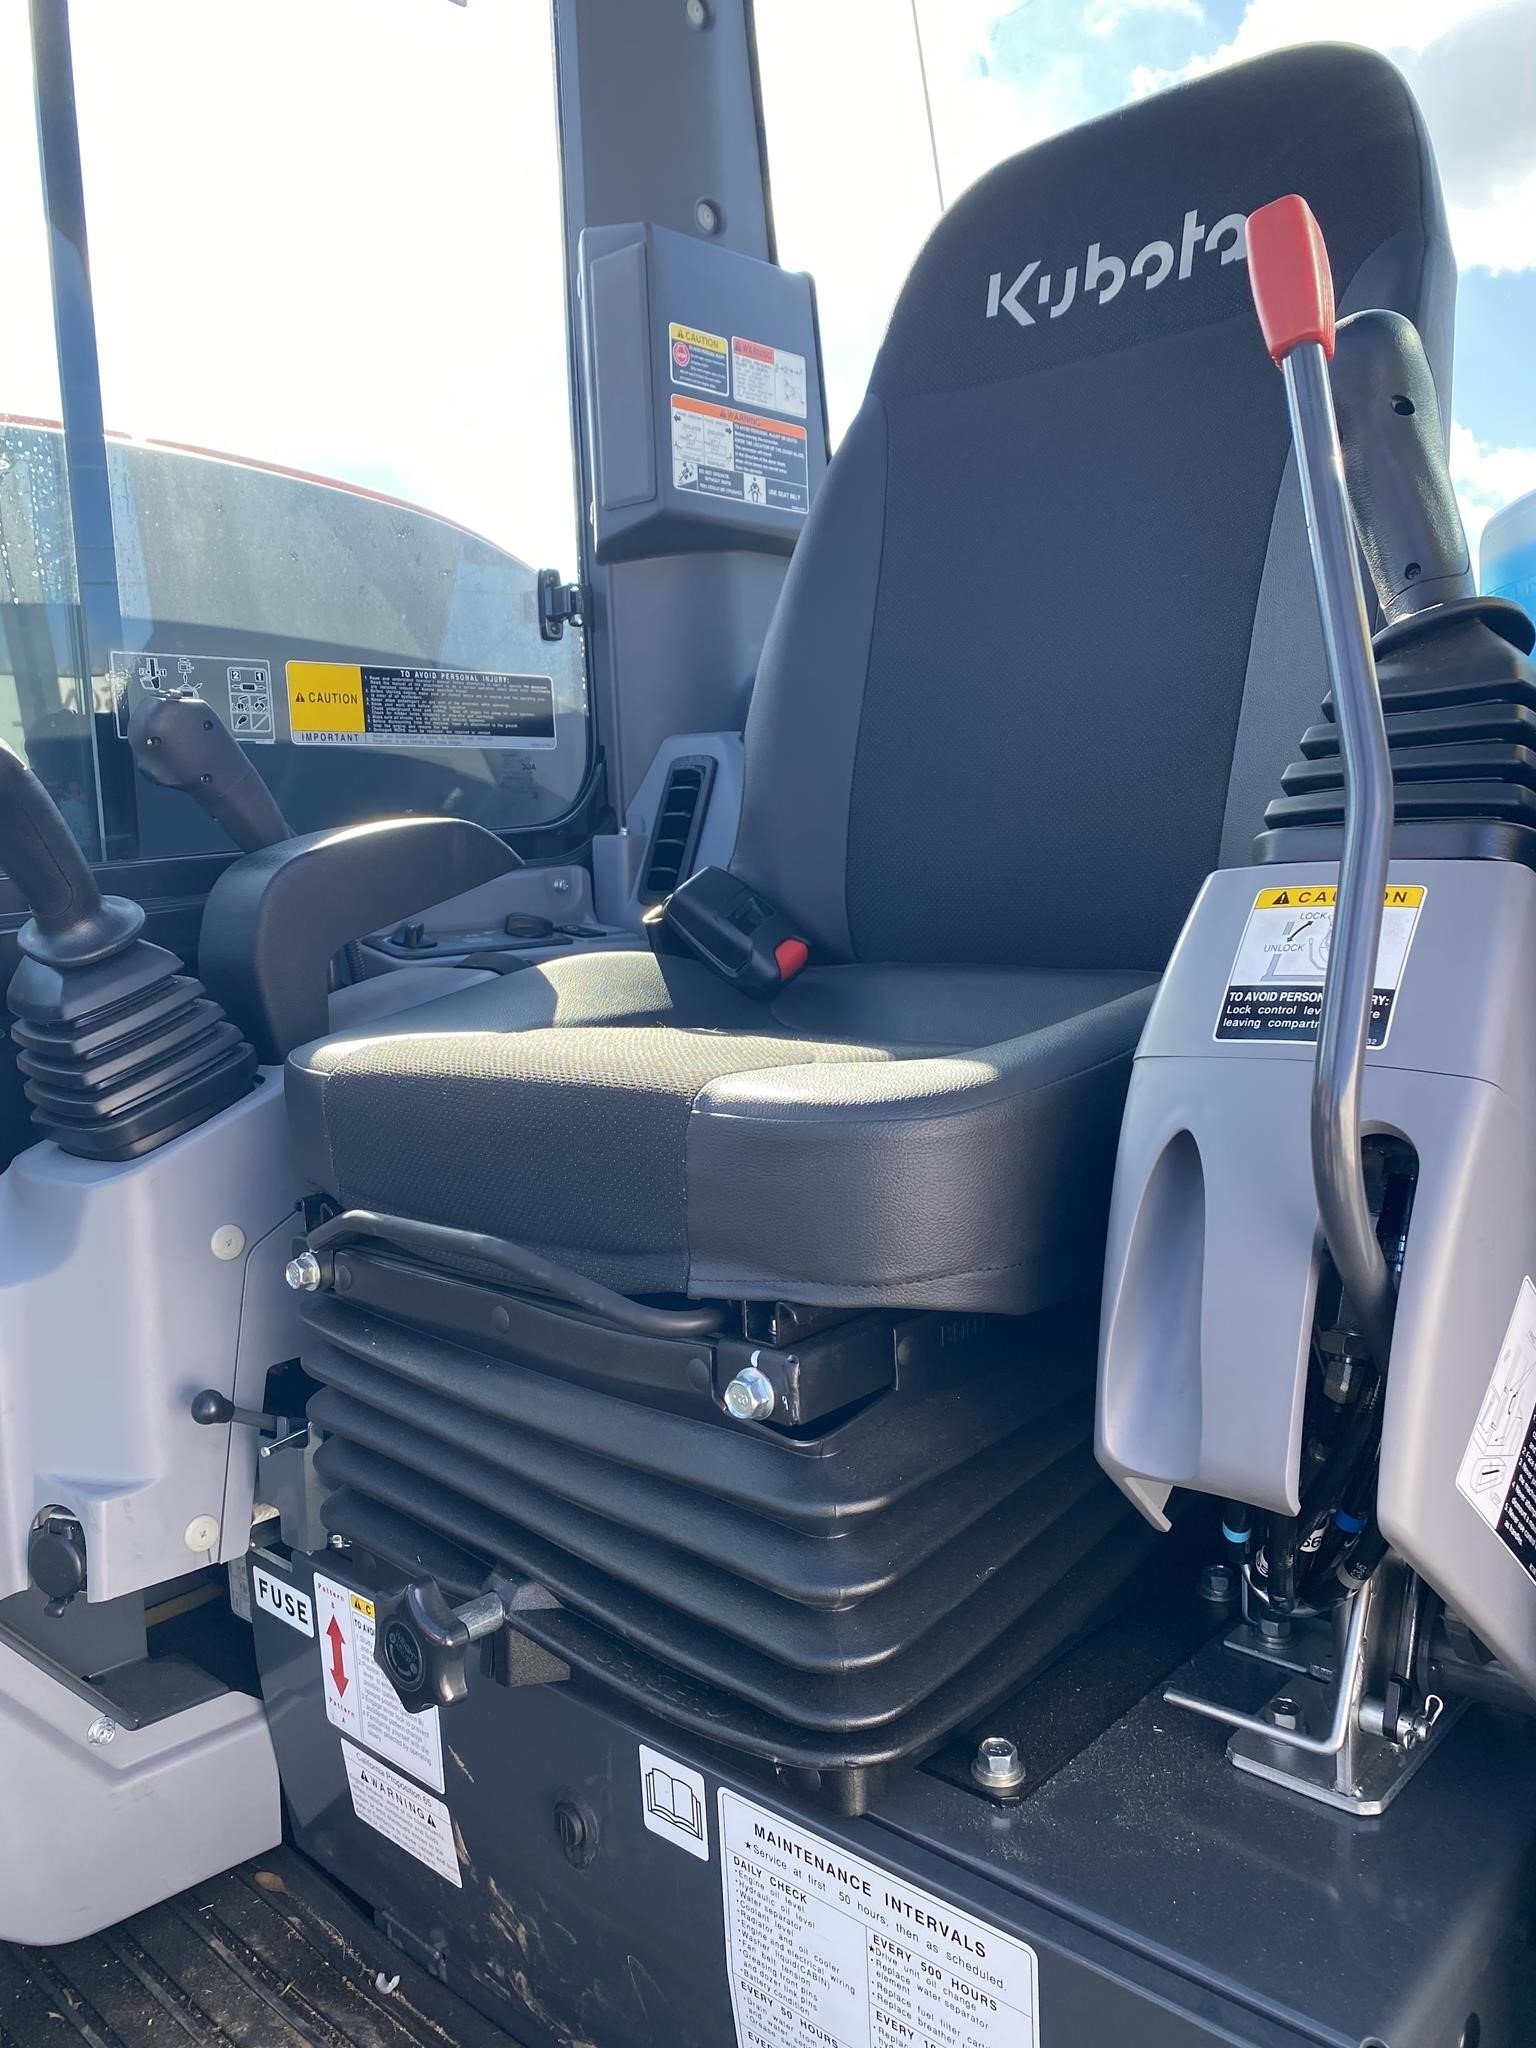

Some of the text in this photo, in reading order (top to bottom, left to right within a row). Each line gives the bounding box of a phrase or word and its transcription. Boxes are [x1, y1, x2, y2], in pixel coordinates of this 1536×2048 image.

[685, 332, 719, 349] CAUTION
[232, 671, 263, 680] 2 1
[401, 670, 410, 678] TO
[415, 671, 437, 679] AVOID
[441, 673, 479, 682] PERSONAL
[308, 692, 358, 704] CAUTION
[302, 732, 359, 742] IMPORTANT
[1300, 912, 1328, 920] LOCK
[1264, 943, 1305, 953] UNLOCK
[1226, 1005, 1321, 1015] Lock control lev
[1229, 991, 1243, 1002] TO
[1244, 991, 1278, 1002] AVOID
[1223, 1017, 1261, 1030] leaving
[258, 1577, 308, 1625] FUSE
[318, 1582, 345, 1602] Pattern
[363, 1623, 375, 1637] AVO
[329, 1696, 355, 1718] Pattern
[371, 1776, 425, 1820] WARNING
[733, 1855, 807, 1905] DAILY CHECK
[738, 1871, 805, 1913] Engine oil level
[754, 1823, 985, 1958] MAINTENANCE INTERVALS
[739, 1880, 815, 1929] Hydraulic oil level
[740, 1890, 802, 1932] Water separator
[740, 1900, 794, 1937] Coolant level
[753, 1844, 1007, 1991] Service at first 50 hours, then as scheduled.
[740, 1909, 840, 1975] Radiator and oil cooler
[741, 1919, 855, 1996] Engine and electrical wiring
[742, 1929, 770, 1951] Washer
[742, 1939, 811, 1987] Fan belt tension
[742, 1949, 818, 2002] Greasing front pins
[873, 1934, 998, 2012] EVERY 500 HOURS
[875, 1947, 977, 2012] Drive unit oil change
[875, 1970, 911, 1995] element
[743, 1960, 818, 2012] and dozer link pins
[743, 1970, 810, 2016] Battery condition
[876, 1959, 989, 2030] Replace water separator
[740, 1980, 839, 2048] EVERY 50 HOURS
[876, 1981, 961, 2037] Replace fuel filter
[876, 2010, 914, 2040] EVERY
[877, 1992, 912, 2020] Replace
[917, 2018, 956, 2045] breather
